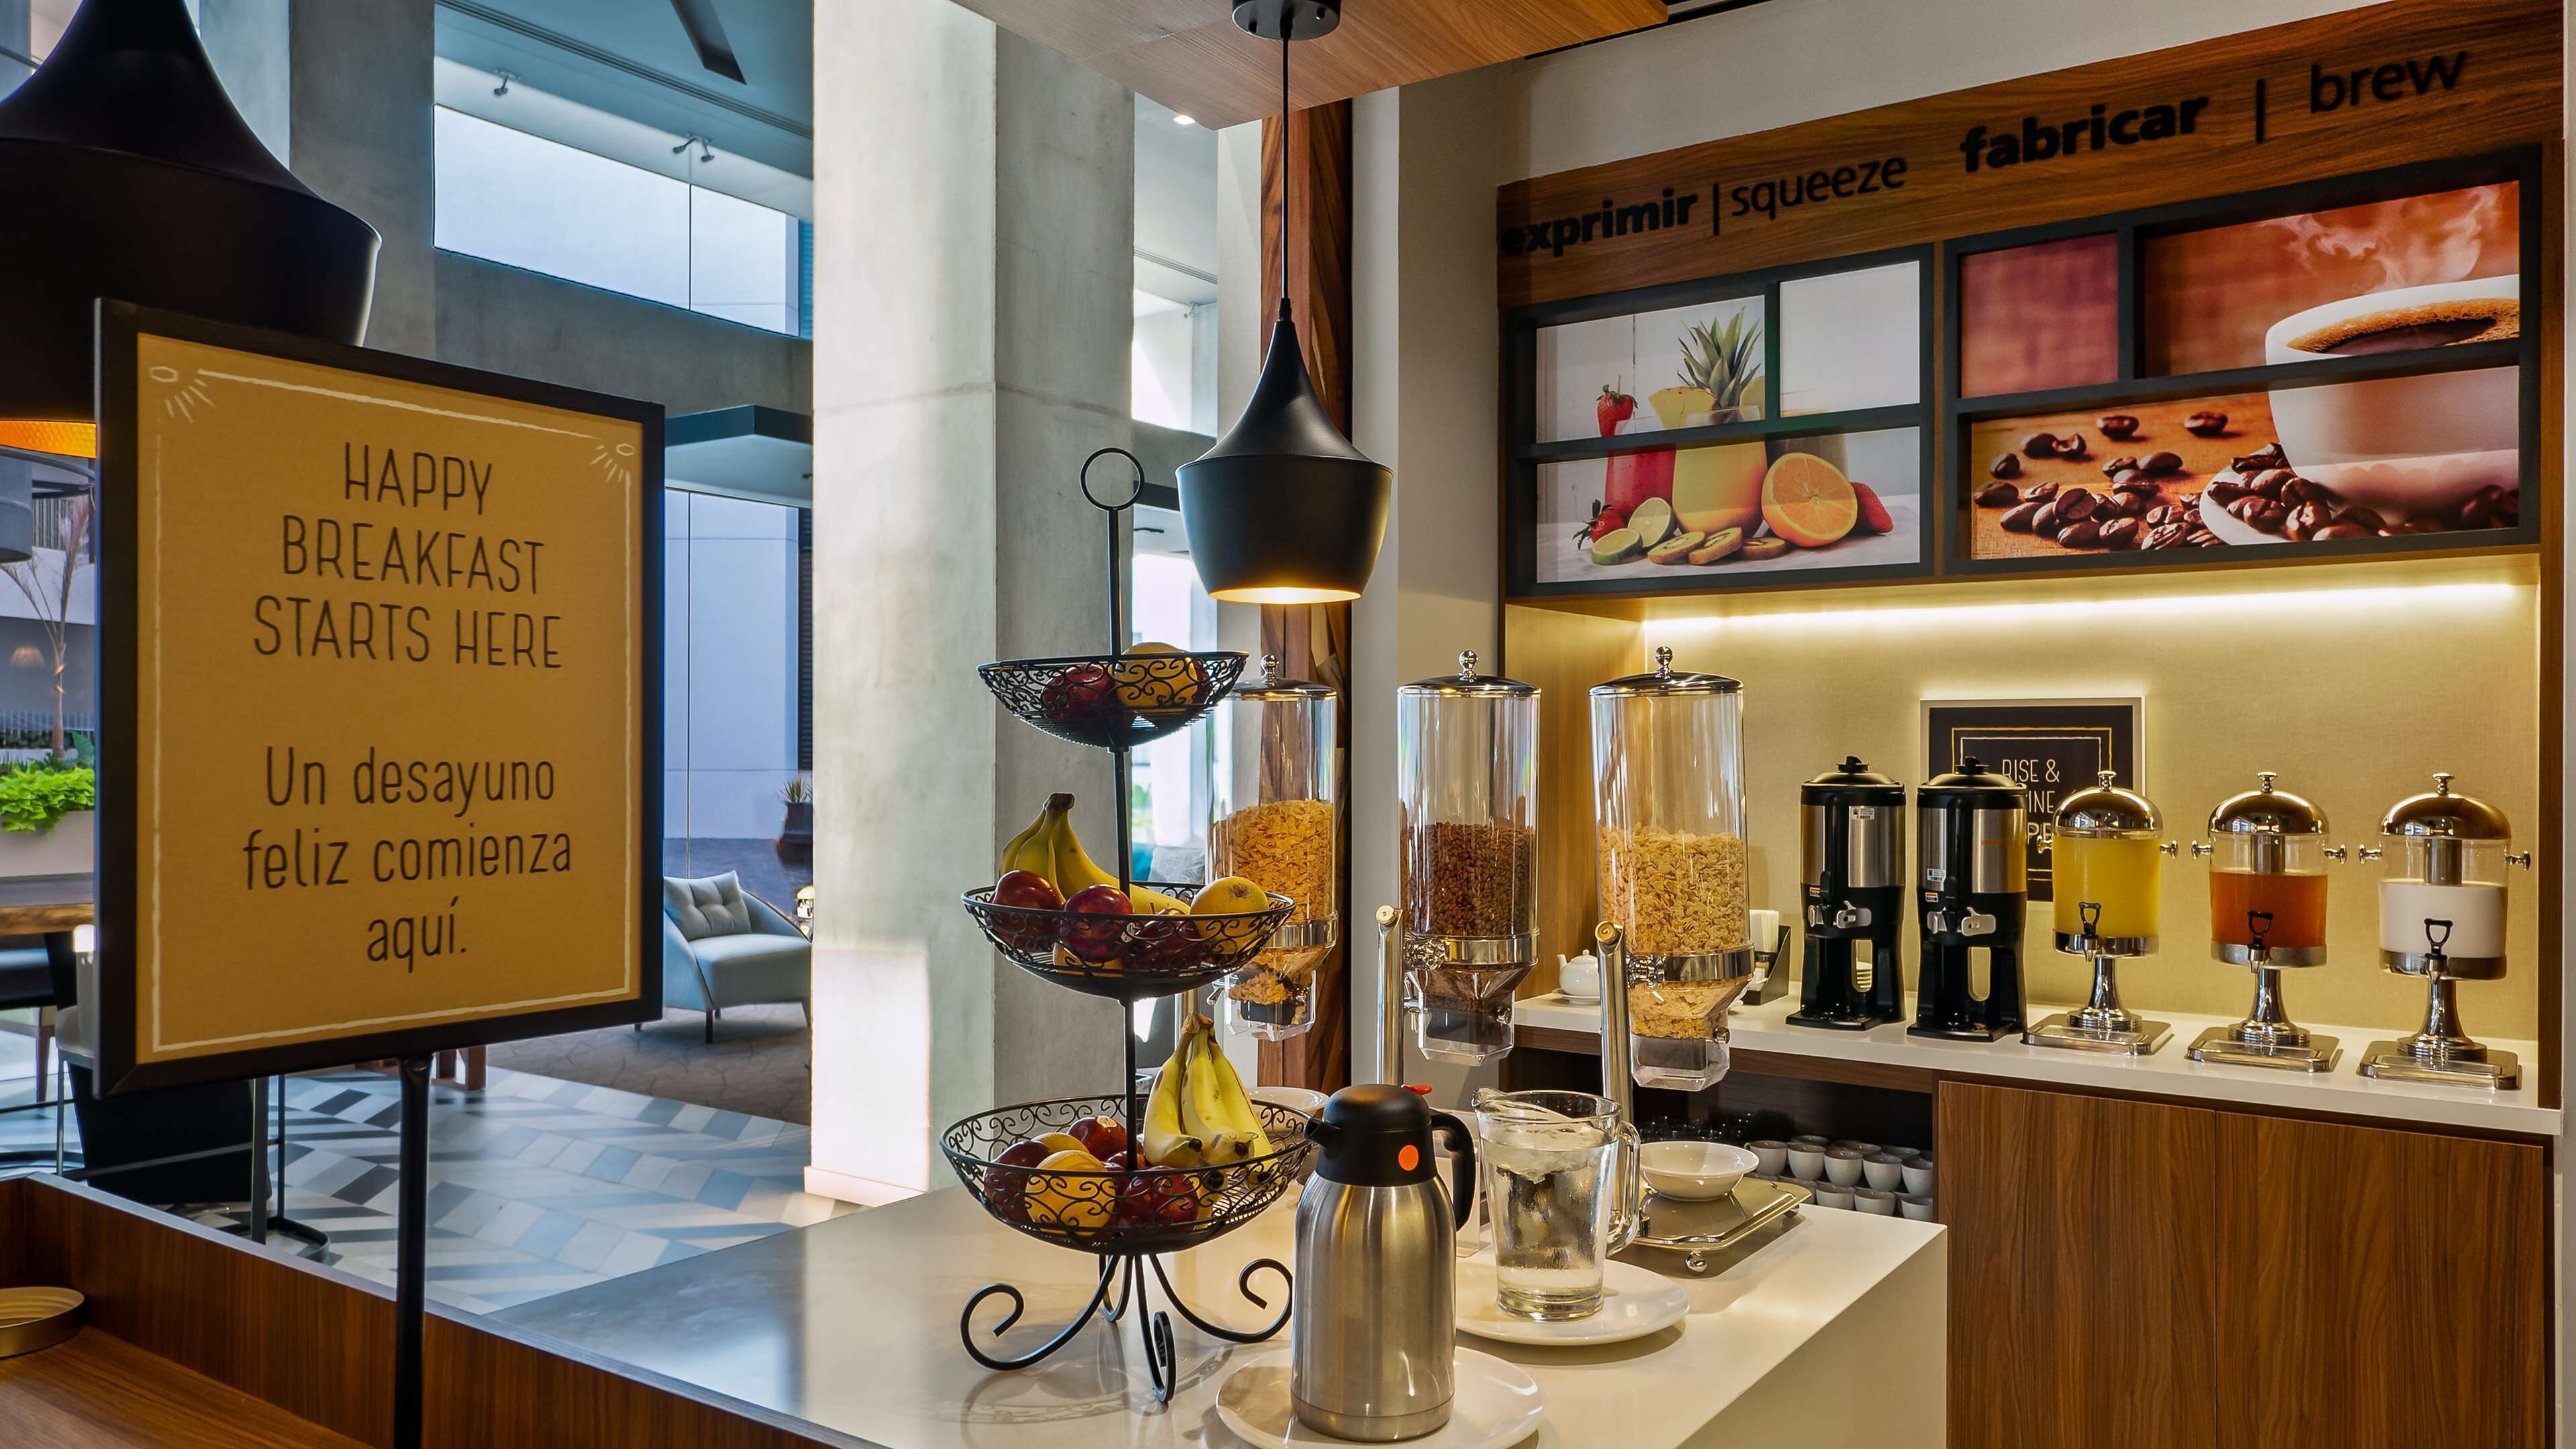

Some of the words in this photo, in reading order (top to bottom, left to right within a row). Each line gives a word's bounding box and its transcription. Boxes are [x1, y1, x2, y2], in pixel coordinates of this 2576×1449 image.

[1960, 95, 2209, 172] fabricar
[2310, 50, 2467, 113] brew
[1501, 188, 1698, 256] exprimir
[1730, 156, 1907, 220] squeeze
[345, 441, 492, 516] HAPPY
[282, 515, 545, 594] BREAKFAST
[254, 594, 430, 662] STARTS
[455, 609, 563, 669] HERE
[266, 746, 327, 806] Un
[354, 746, 555, 818] desayuno
[2002, 759, 2039, 782] RISE
[2045, 759, 2059, 782] &
[2026, 790, 2055, 813] INE
[242, 826, 349, 890] feliz
[373, 822, 571, 883] comienza
[367, 894, 468, 973] aquí.
